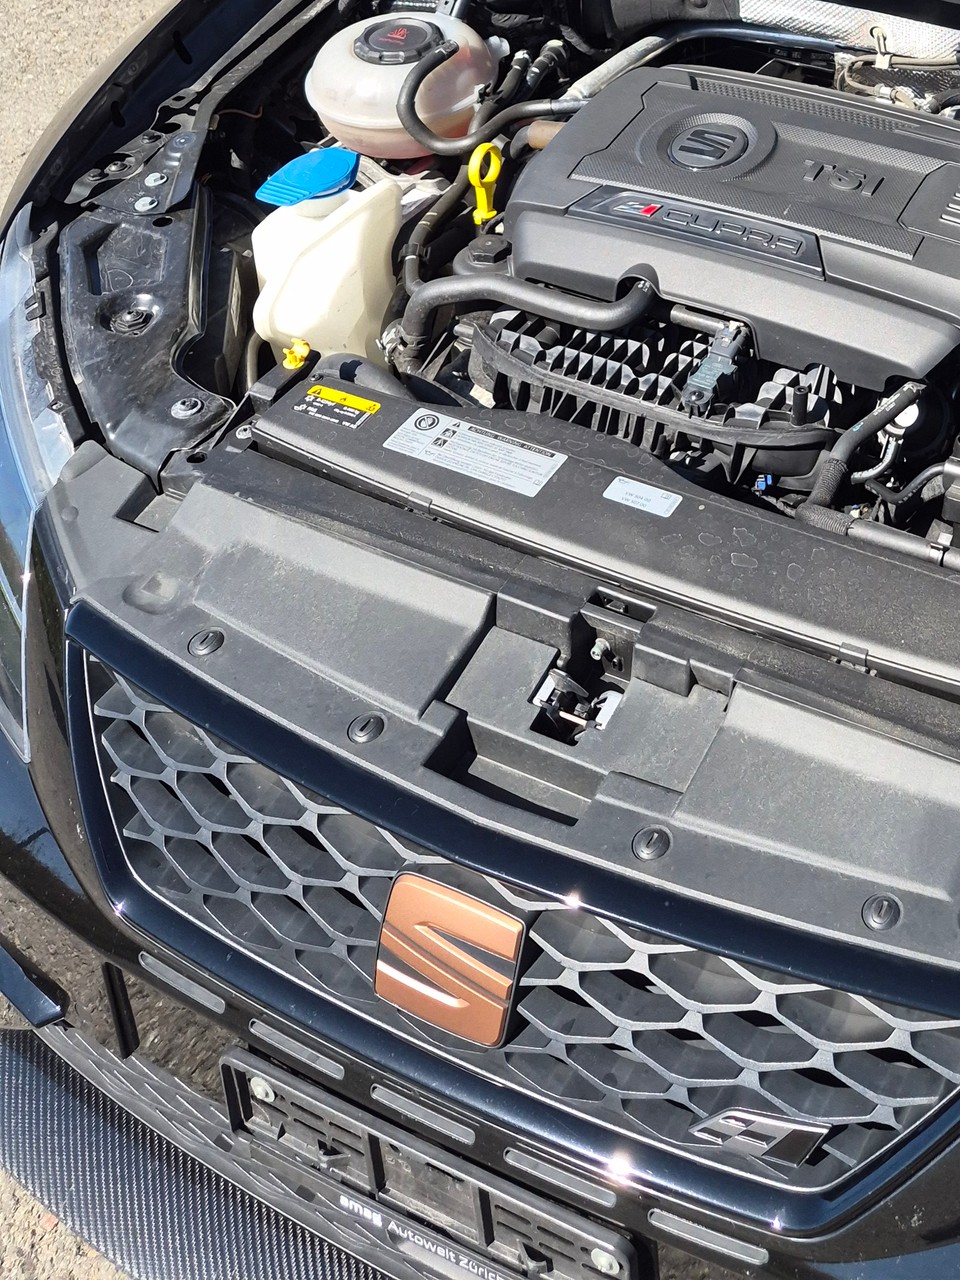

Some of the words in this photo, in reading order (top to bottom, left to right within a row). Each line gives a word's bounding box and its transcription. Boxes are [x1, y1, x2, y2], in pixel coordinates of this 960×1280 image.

[802, 158, 886, 197] TSI
[662, 208, 804, 256] CUPRA
[470, 427, 495, 438] ACHTUNG
[496, 435, 521, 447] WARNING
[523, 444, 552, 457] ATTENTION
[339, 1194, 383, 1228] amag
[387, 1220, 458, 1263] Autowelt
